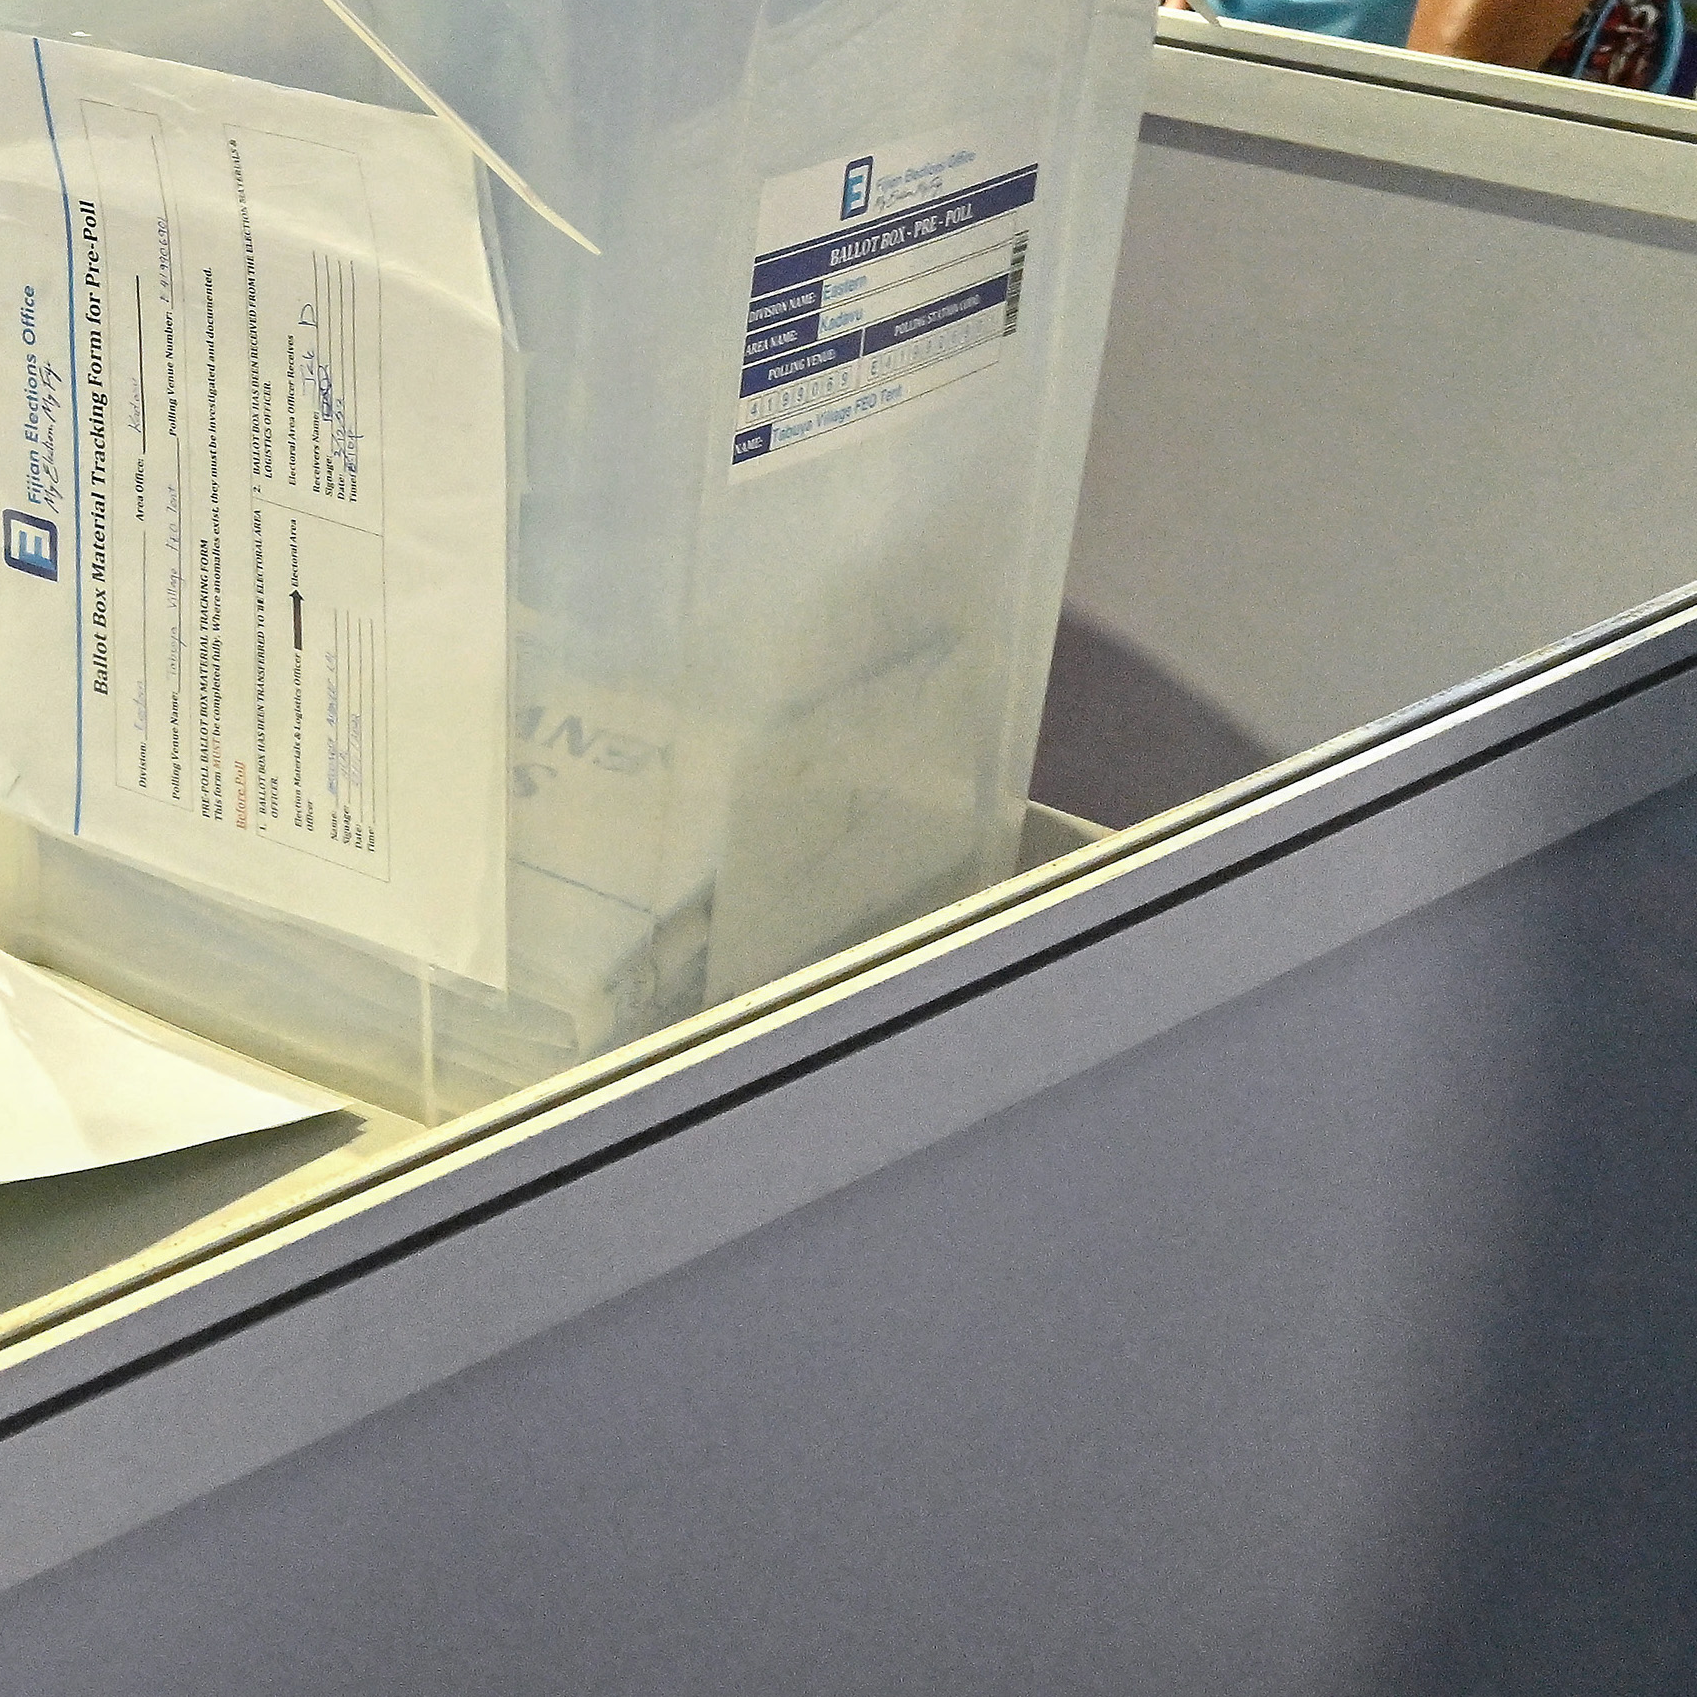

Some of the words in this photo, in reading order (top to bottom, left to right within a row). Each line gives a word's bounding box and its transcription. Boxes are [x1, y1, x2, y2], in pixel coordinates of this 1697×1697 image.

[80, 200, 99, 288] Pre-Poll
[830, 235, 879, 266] BALLOT
[880, 227, 905, 252] BOX
[913, 216, 937, 238] PRE
[945, 204, 973, 233] POLL
[20, 285, 37, 345] Office
[86, 292, 101, 325] for
[204, 267, 214, 338] documented.
[749, 302, 786, 322] DIVISION
[165, 312, 173, 359] Number:
[206, 340, 214, 362] and
[746, 343, 768, 356] AREA
[87, 330, 103, 387] Form
[286, 335, 295, 378] Receives
[768, 361, 806, 380] POLLING
[166, 362, 175, 394] Venue
[24, 354, 39, 443] Elections
[207, 364, 218, 433] investigated
[287, 380, 295, 414] Officer
[167, 399, 177, 436] Polling
[288, 416, 296, 439] Area
[311, 413, 320, 443] Name:
[89, 393, 107, 486] Tracking
[209, 435, 217, 448] be
[27, 451, 43, 503] Fijian
[136, 459, 144, 492] Office:
[209, 450, 218, 477] must
[288, 441, 297, 486] Electoral
[312, 445, 321, 492] Receivers
[136, 497, 144, 521] Area
[210, 480, 221, 504] they
[89, 491, 105, 582] Material
[200, 539, 208, 572] FORM
[212, 537, 221, 594] anomalies
[92, 589, 106, 628] Box
[200, 575, 209, 632] TRACKING
[211, 596, 221, 632] Where
[93, 634, 108, 695] Ballot
[200, 635, 209, 692] MATERIAL
[212, 635, 223, 661] fully.
[170, 693, 178, 726] Name:
[200, 695, 208, 718] BOX
[212, 664, 223, 721] completed
[171, 728, 179, 760] Venue
[200, 720, 209, 763] BALLOT
[212, 722, 221, 736] be
[138, 742, 147, 788] Division:
[212, 738, 221, 769] MUST
[171, 763, 181, 800] Polling
[200, 765, 210, 817] PRE-POLL
[213, 772, 221, 797] form
[235, 761, 245, 786] Poll
[214, 800, 222, 821] This
[236, 788, 246, 829] Before
